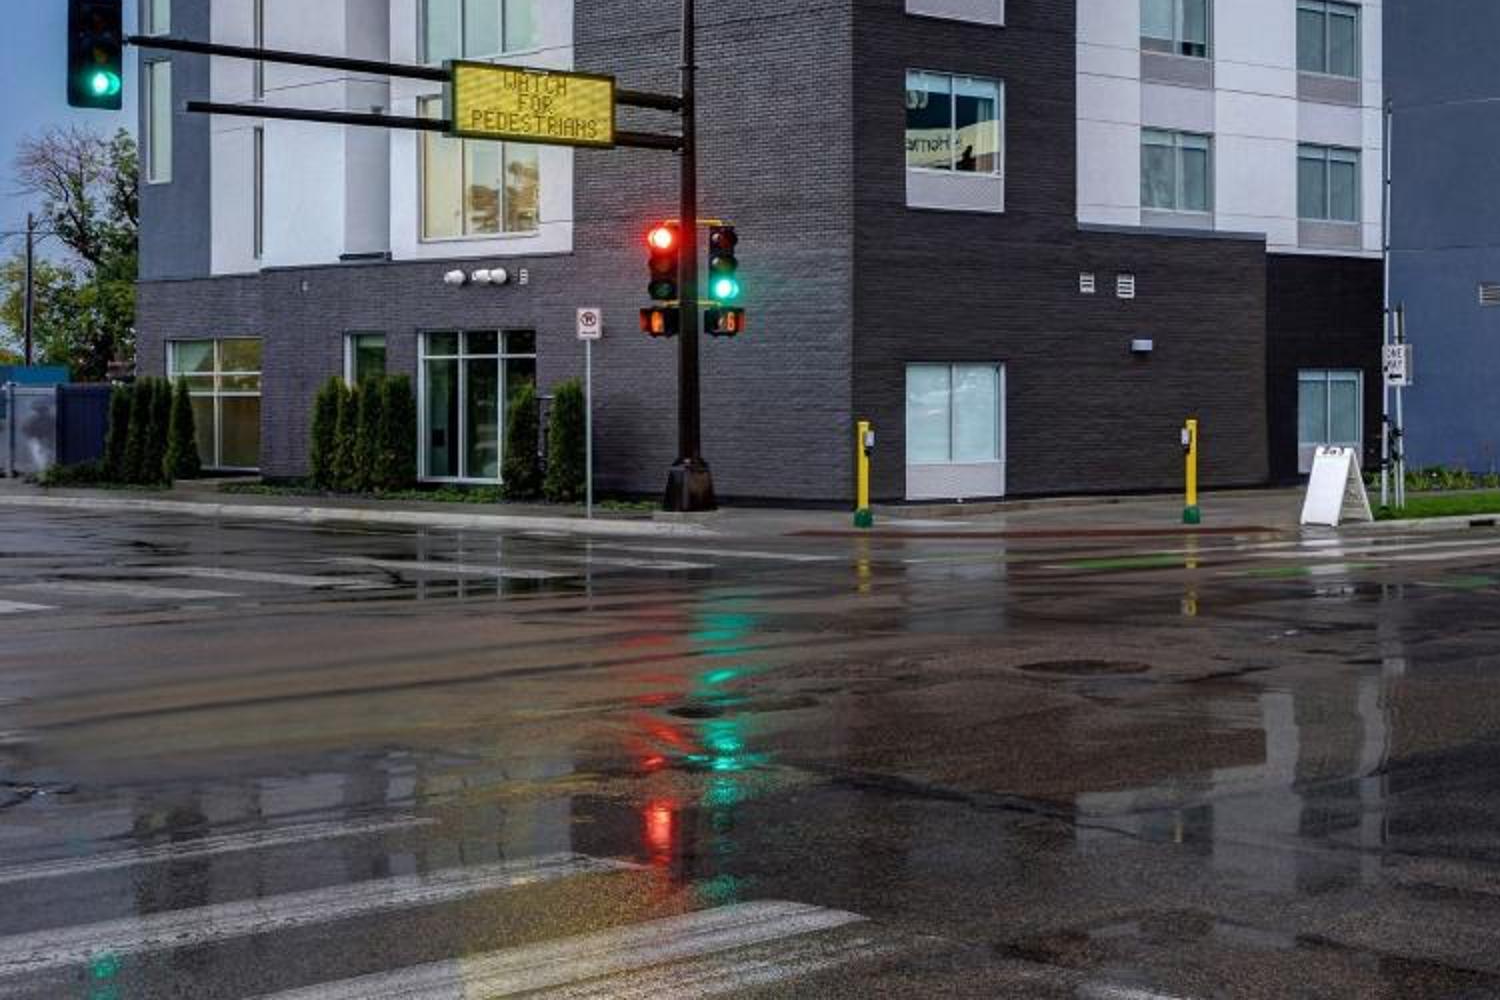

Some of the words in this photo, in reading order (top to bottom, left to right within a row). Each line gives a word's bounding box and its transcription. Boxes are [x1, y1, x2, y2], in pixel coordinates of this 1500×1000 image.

[503, 71, 567, 97] WATCH
[517, 93, 553, 114] FOR
[471, 109, 598, 138] PEDESTRIANS
